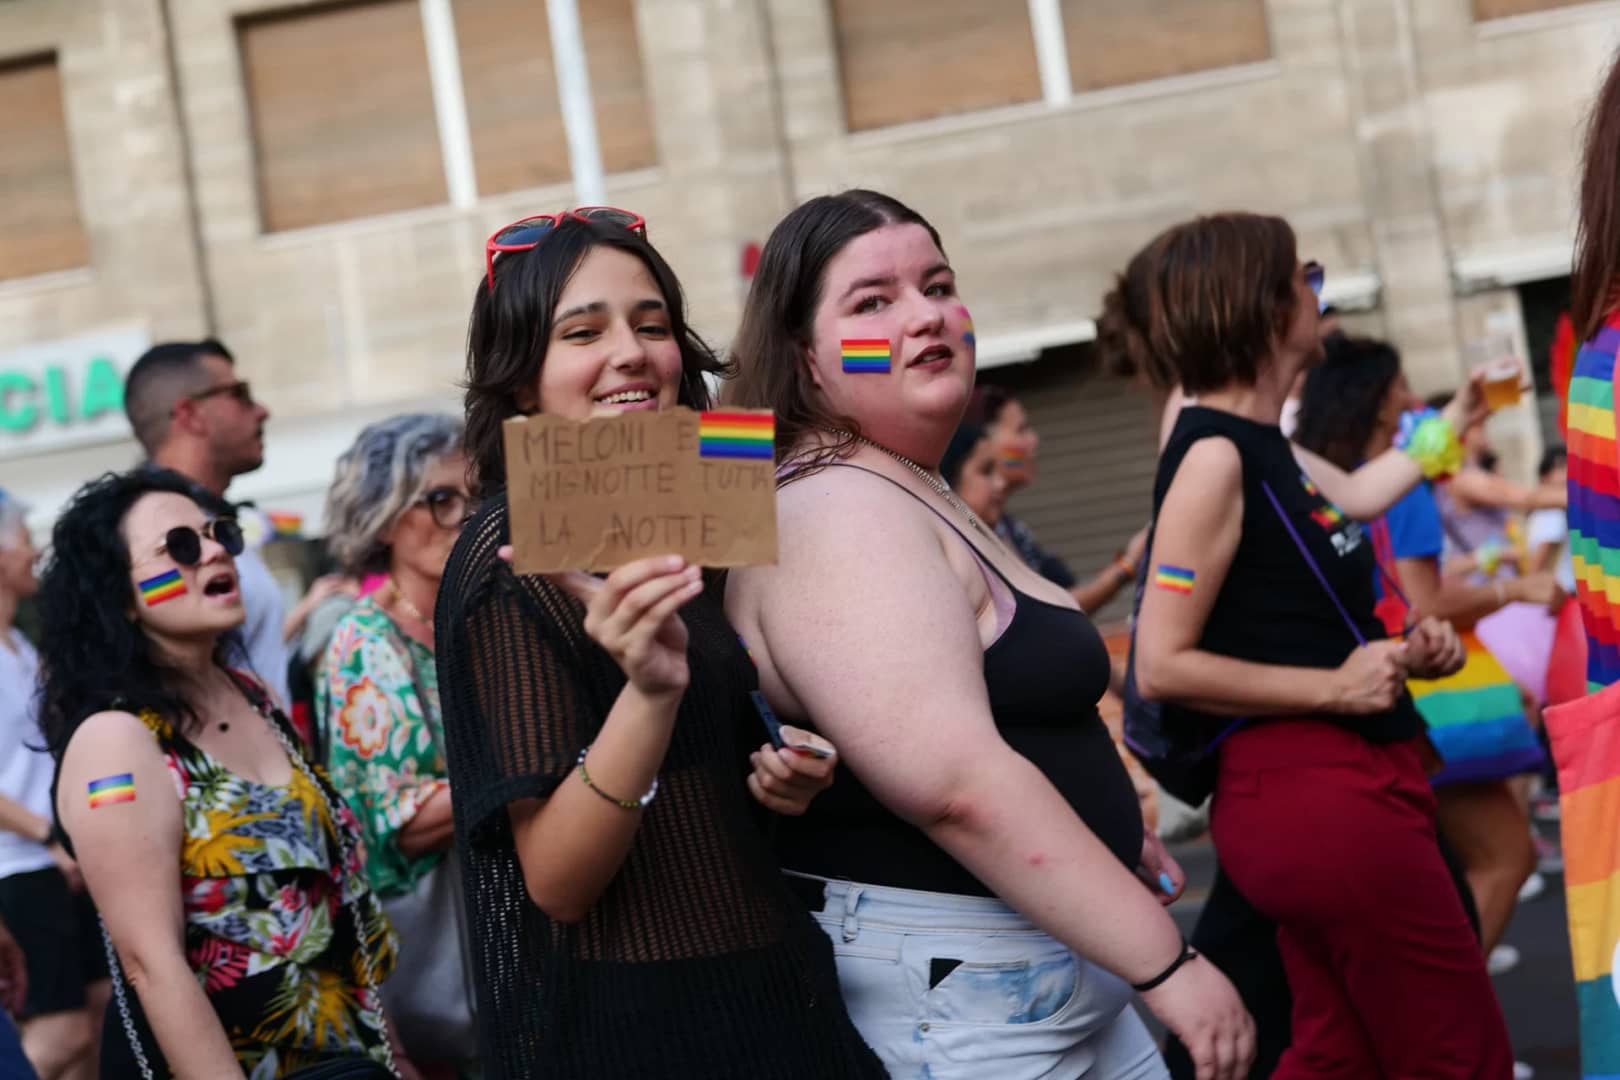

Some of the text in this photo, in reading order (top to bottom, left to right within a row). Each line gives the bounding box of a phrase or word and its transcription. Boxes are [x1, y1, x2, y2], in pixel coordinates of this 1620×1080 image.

[522, 420, 697, 466] MELONI E
[529, 462, 676, 500] MIGNOTTE
[538, 511, 718, 550] LA NOTTE
